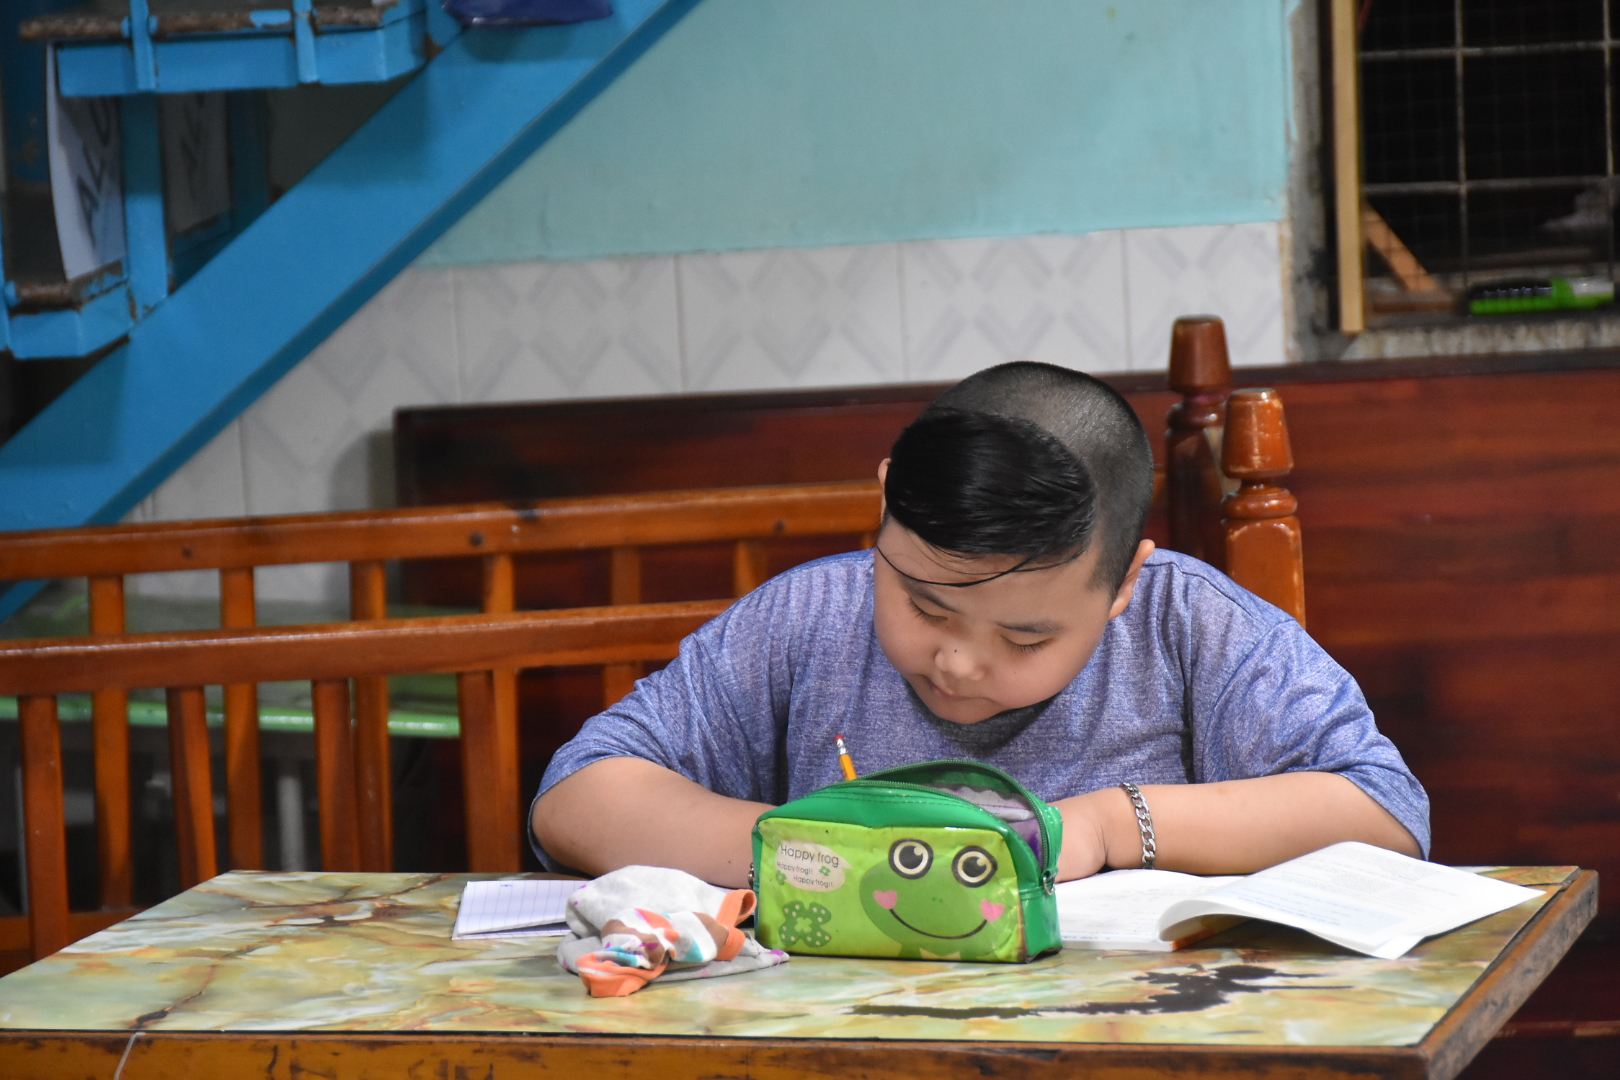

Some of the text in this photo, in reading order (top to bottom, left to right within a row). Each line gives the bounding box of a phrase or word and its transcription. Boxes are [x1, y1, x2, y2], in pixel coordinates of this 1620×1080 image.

[780, 844, 839, 868] Happy frog
[777, 861, 795, 872] Happy
[793, 875, 814, 885] Happy
